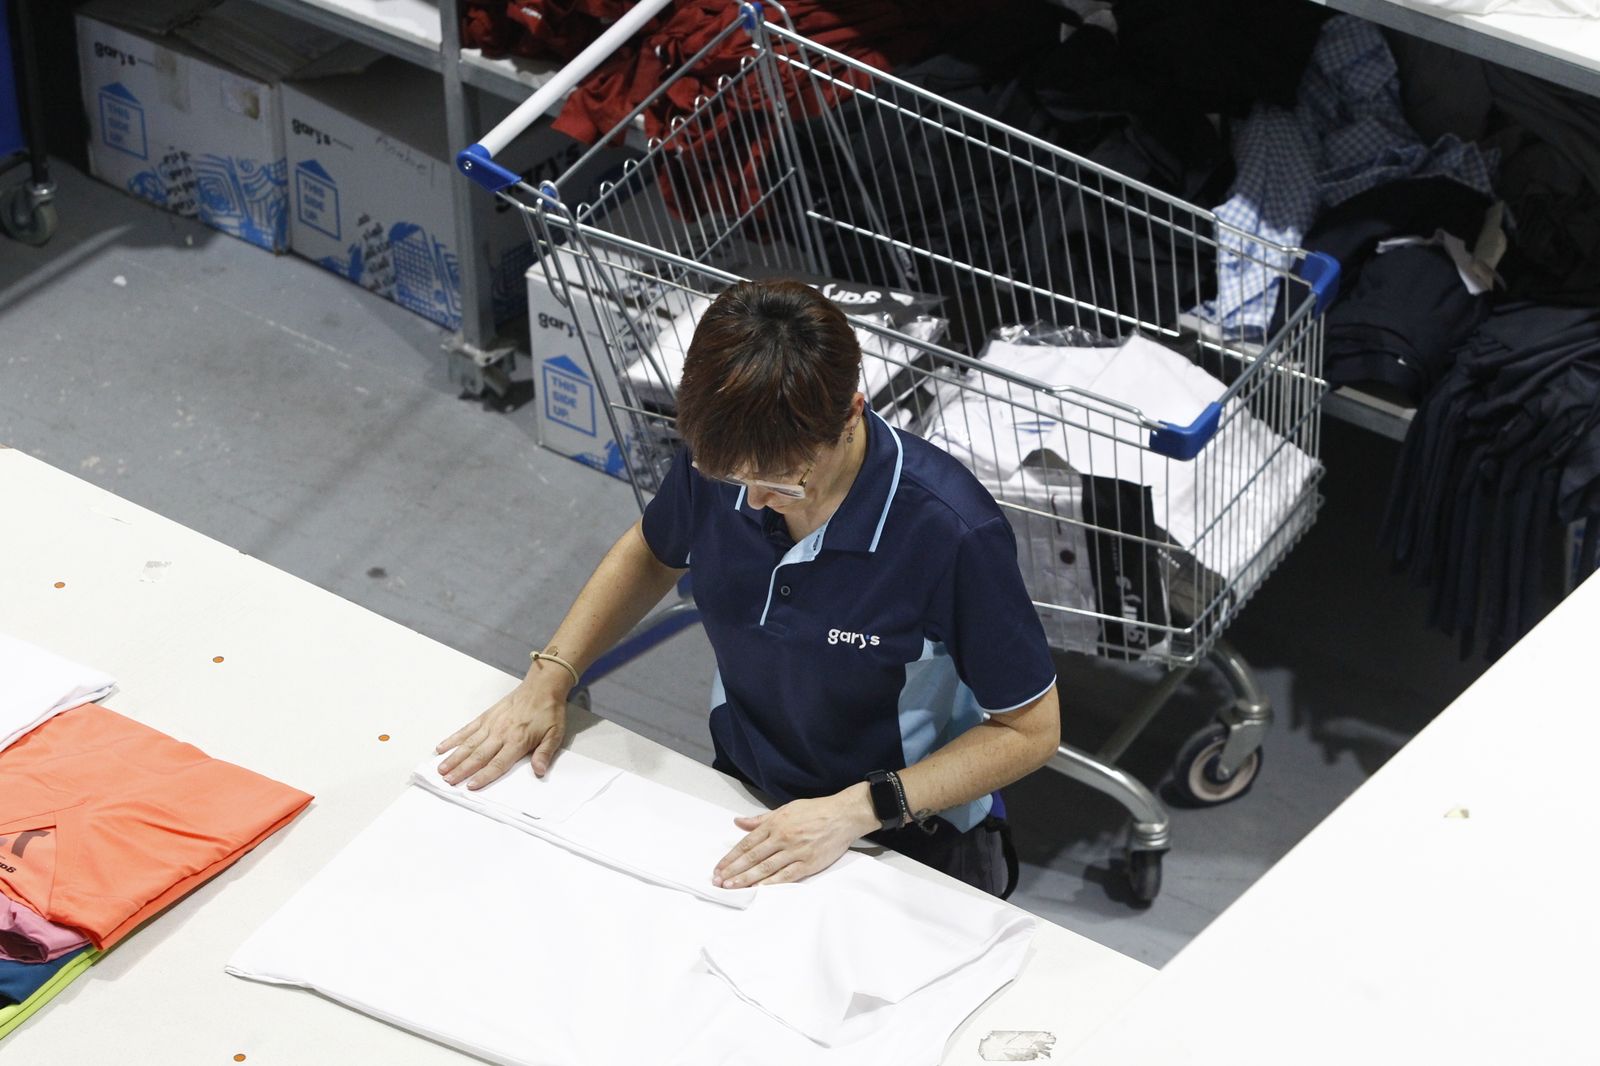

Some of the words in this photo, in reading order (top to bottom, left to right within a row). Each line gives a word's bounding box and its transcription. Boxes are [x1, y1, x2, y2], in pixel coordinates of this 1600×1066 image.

[550, 375, 578, 395] THIS
[551, 390, 578, 409] SIDE
[827, 628, 881, 649] gary's
